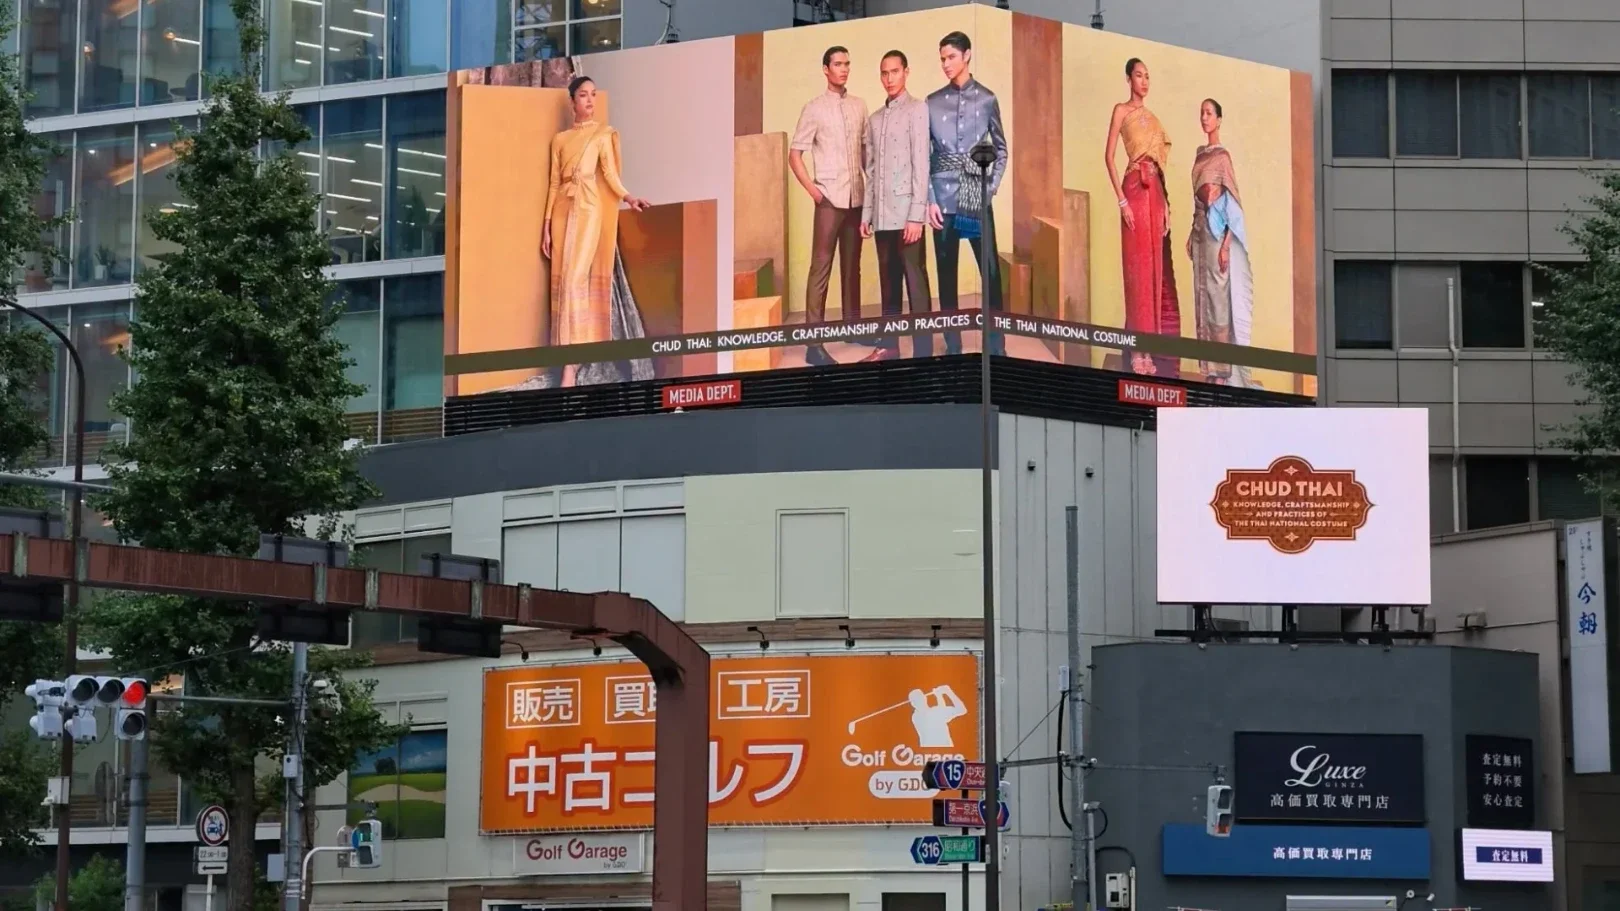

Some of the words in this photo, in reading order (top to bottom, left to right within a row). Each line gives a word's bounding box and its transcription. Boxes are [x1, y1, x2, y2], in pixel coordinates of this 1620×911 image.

[652, 339, 681, 353] CHUD
[686, 336, 712, 349] THAI:
[792, 321, 879, 341] CRAFTSMANSHIP
[884, 319, 909, 332] AND
[915, 314, 970, 330] PRACTICES
[994, 316, 1011, 329] THE
[1016, 319, 1037, 333] THAI
[1042, 324, 1089, 341] NATIONAL
[1093, 331, 1136, 347] COSTUME
[669, 386, 704, 404] MEDIA
[706, 384, 736, 401] DEPT.
[1124, 384, 1155, 402] MEDIA
[1157, 387, 1184, 405] DEPT.
[1236, 481, 1292, 497] CHUD
[1295, 481, 1343, 497] THAI
[1285, 501, 1350, 509] CRAFTSMANSHIP
[1577, 582, 1598, 635] 今朝
[512, 684, 574, 723] 販売
[726, 677, 802, 714] 工房
[842, 745, 887, 767] Golf
[1482, 752, 1522, 768] 査定無料
[947, 763, 962, 781] 15
[1284, 745, 1367, 788] Luxe
[875, 776, 893, 793] by
[1483, 772, 1522, 788] 予約不要
[1270, 792, 1390, 810] 高価買取専門店
[1483, 793, 1524, 809] 安心査定
[526, 839, 563, 860] Golf
[567, 838, 627, 861] Garage
[921, 843, 940, 857] 316
[1273, 846, 1373, 862] 高価買取専門店
[1491, 848, 1529, 864] 査定無料
